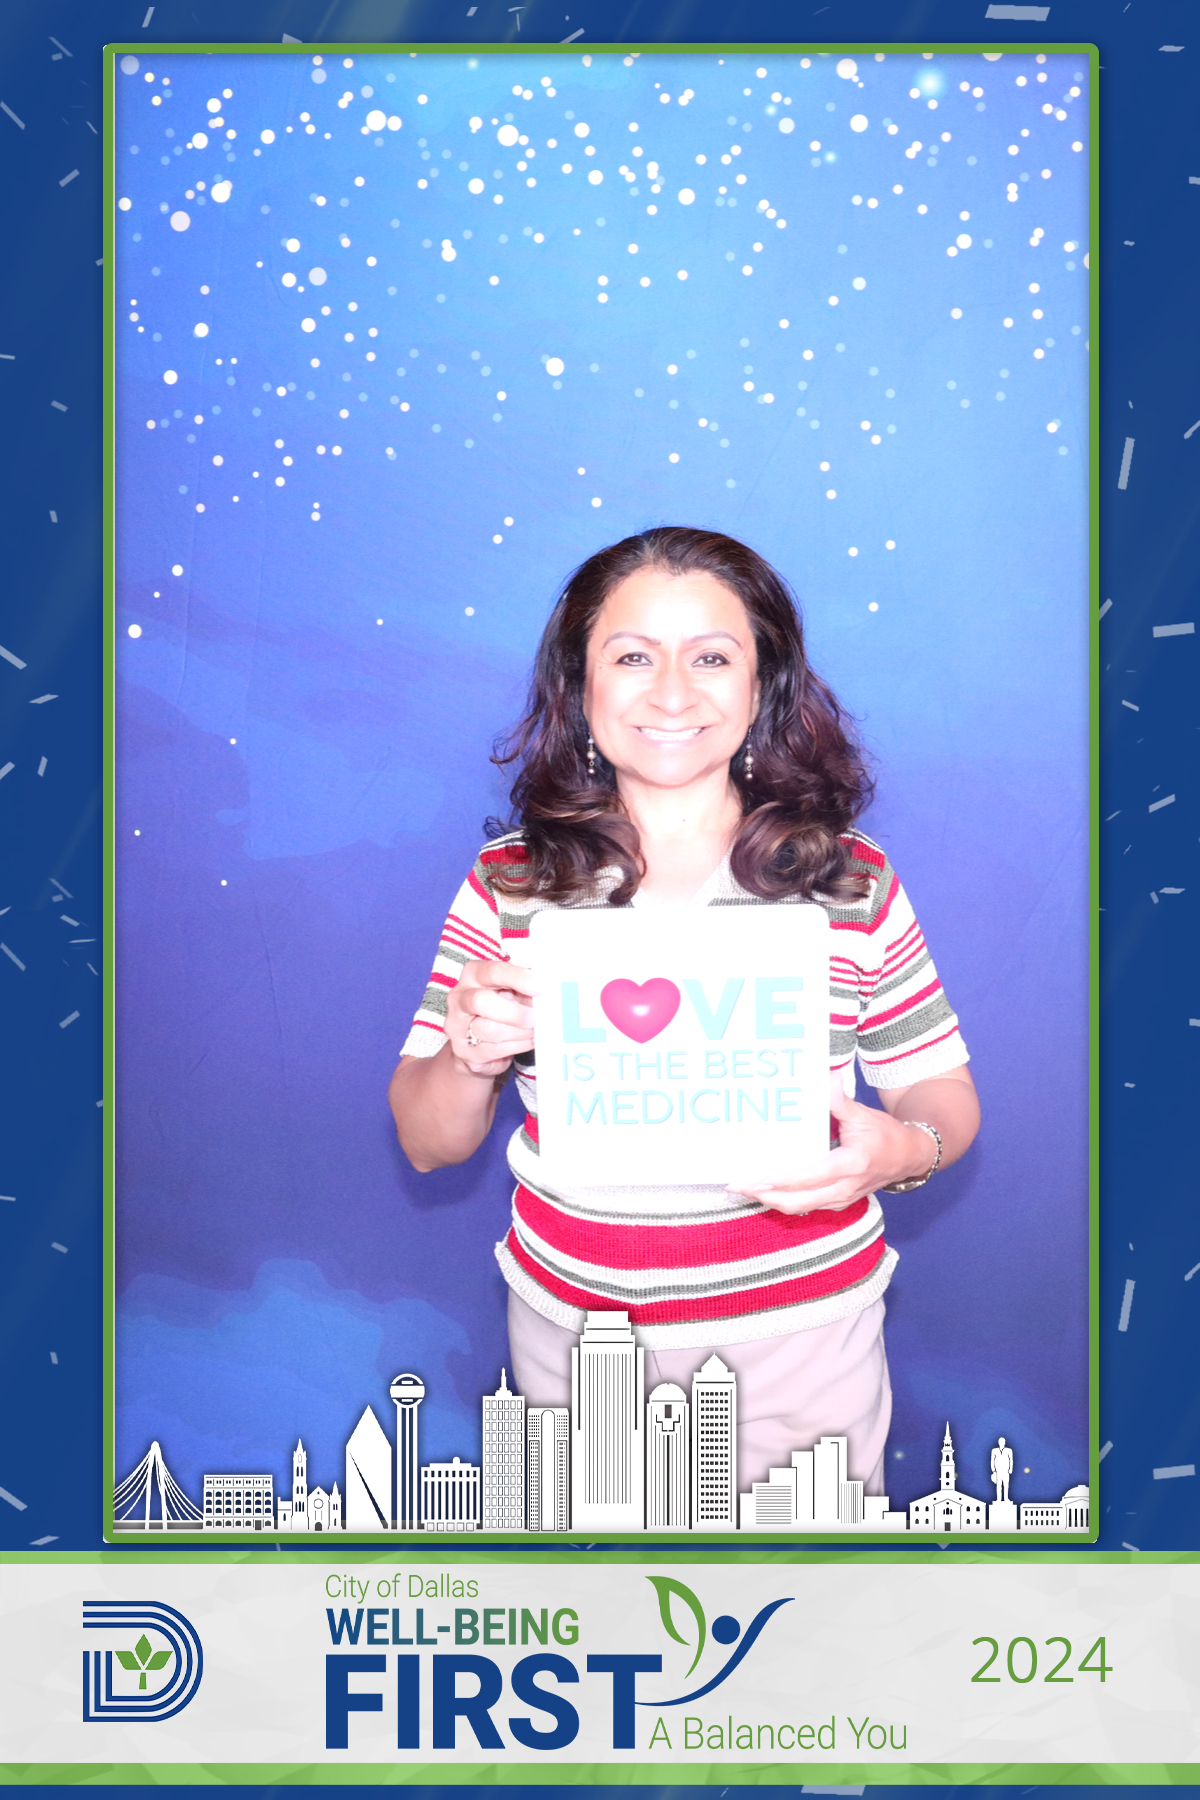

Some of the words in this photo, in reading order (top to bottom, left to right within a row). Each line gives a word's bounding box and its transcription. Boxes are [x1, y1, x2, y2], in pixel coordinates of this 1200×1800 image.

[562, 1053, 595, 1082] IS
[609, 1051, 688, 1080] THE
[704, 1048, 803, 1079] BEST
[566, 1087, 802, 1125] MEDICINE
